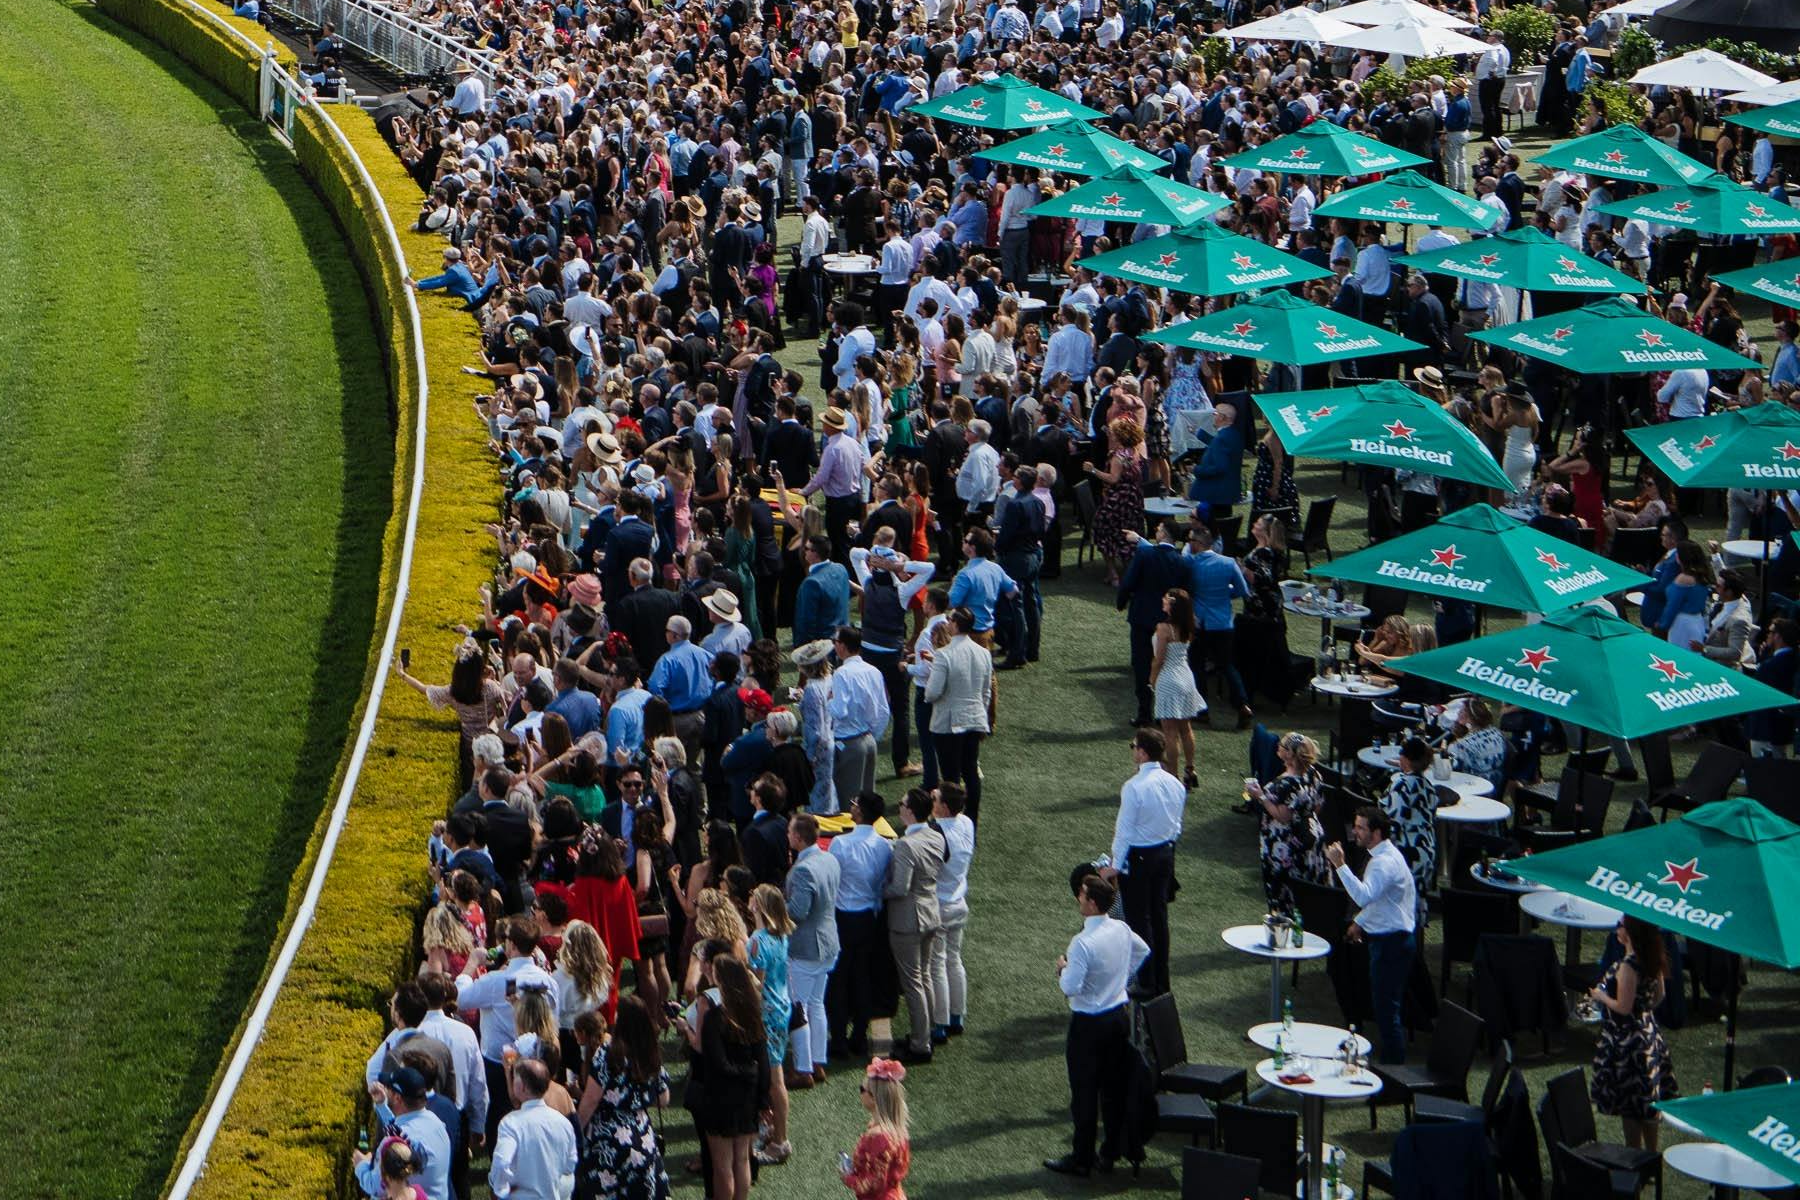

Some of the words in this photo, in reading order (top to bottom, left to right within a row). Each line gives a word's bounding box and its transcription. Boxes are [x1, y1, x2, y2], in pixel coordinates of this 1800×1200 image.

[1020, 108, 1073, 123] Heineken
[1016, 151, 1085, 170] Heineken
[1256, 157, 1325, 171] Heineken
[1573, 157, 1650, 177] Heineken
[1069, 203, 1145, 218] Heineken
[1359, 206, 1440, 222] Heineken
[1118, 259, 1188, 283] Heineken
[1226, 264, 1293, 286] Heineken
[1437, 258, 1508, 279] Heineken
[1549, 273, 1616, 289] Heineken
[1188, 330, 1269, 352] Heineken
[1314, 335, 1382, 354] Heineken
[1621, 348, 1709, 364] Heineken
[1351, 438, 1454, 466] Heineken
[1377, 560, 1492, 594] Heineken
[1544, 564, 1610, 596] Heineken
[1457, 657, 1580, 706] Heineken
[1646, 677, 1740, 712] Heineken
[1586, 865, 1734, 930] Heineken
